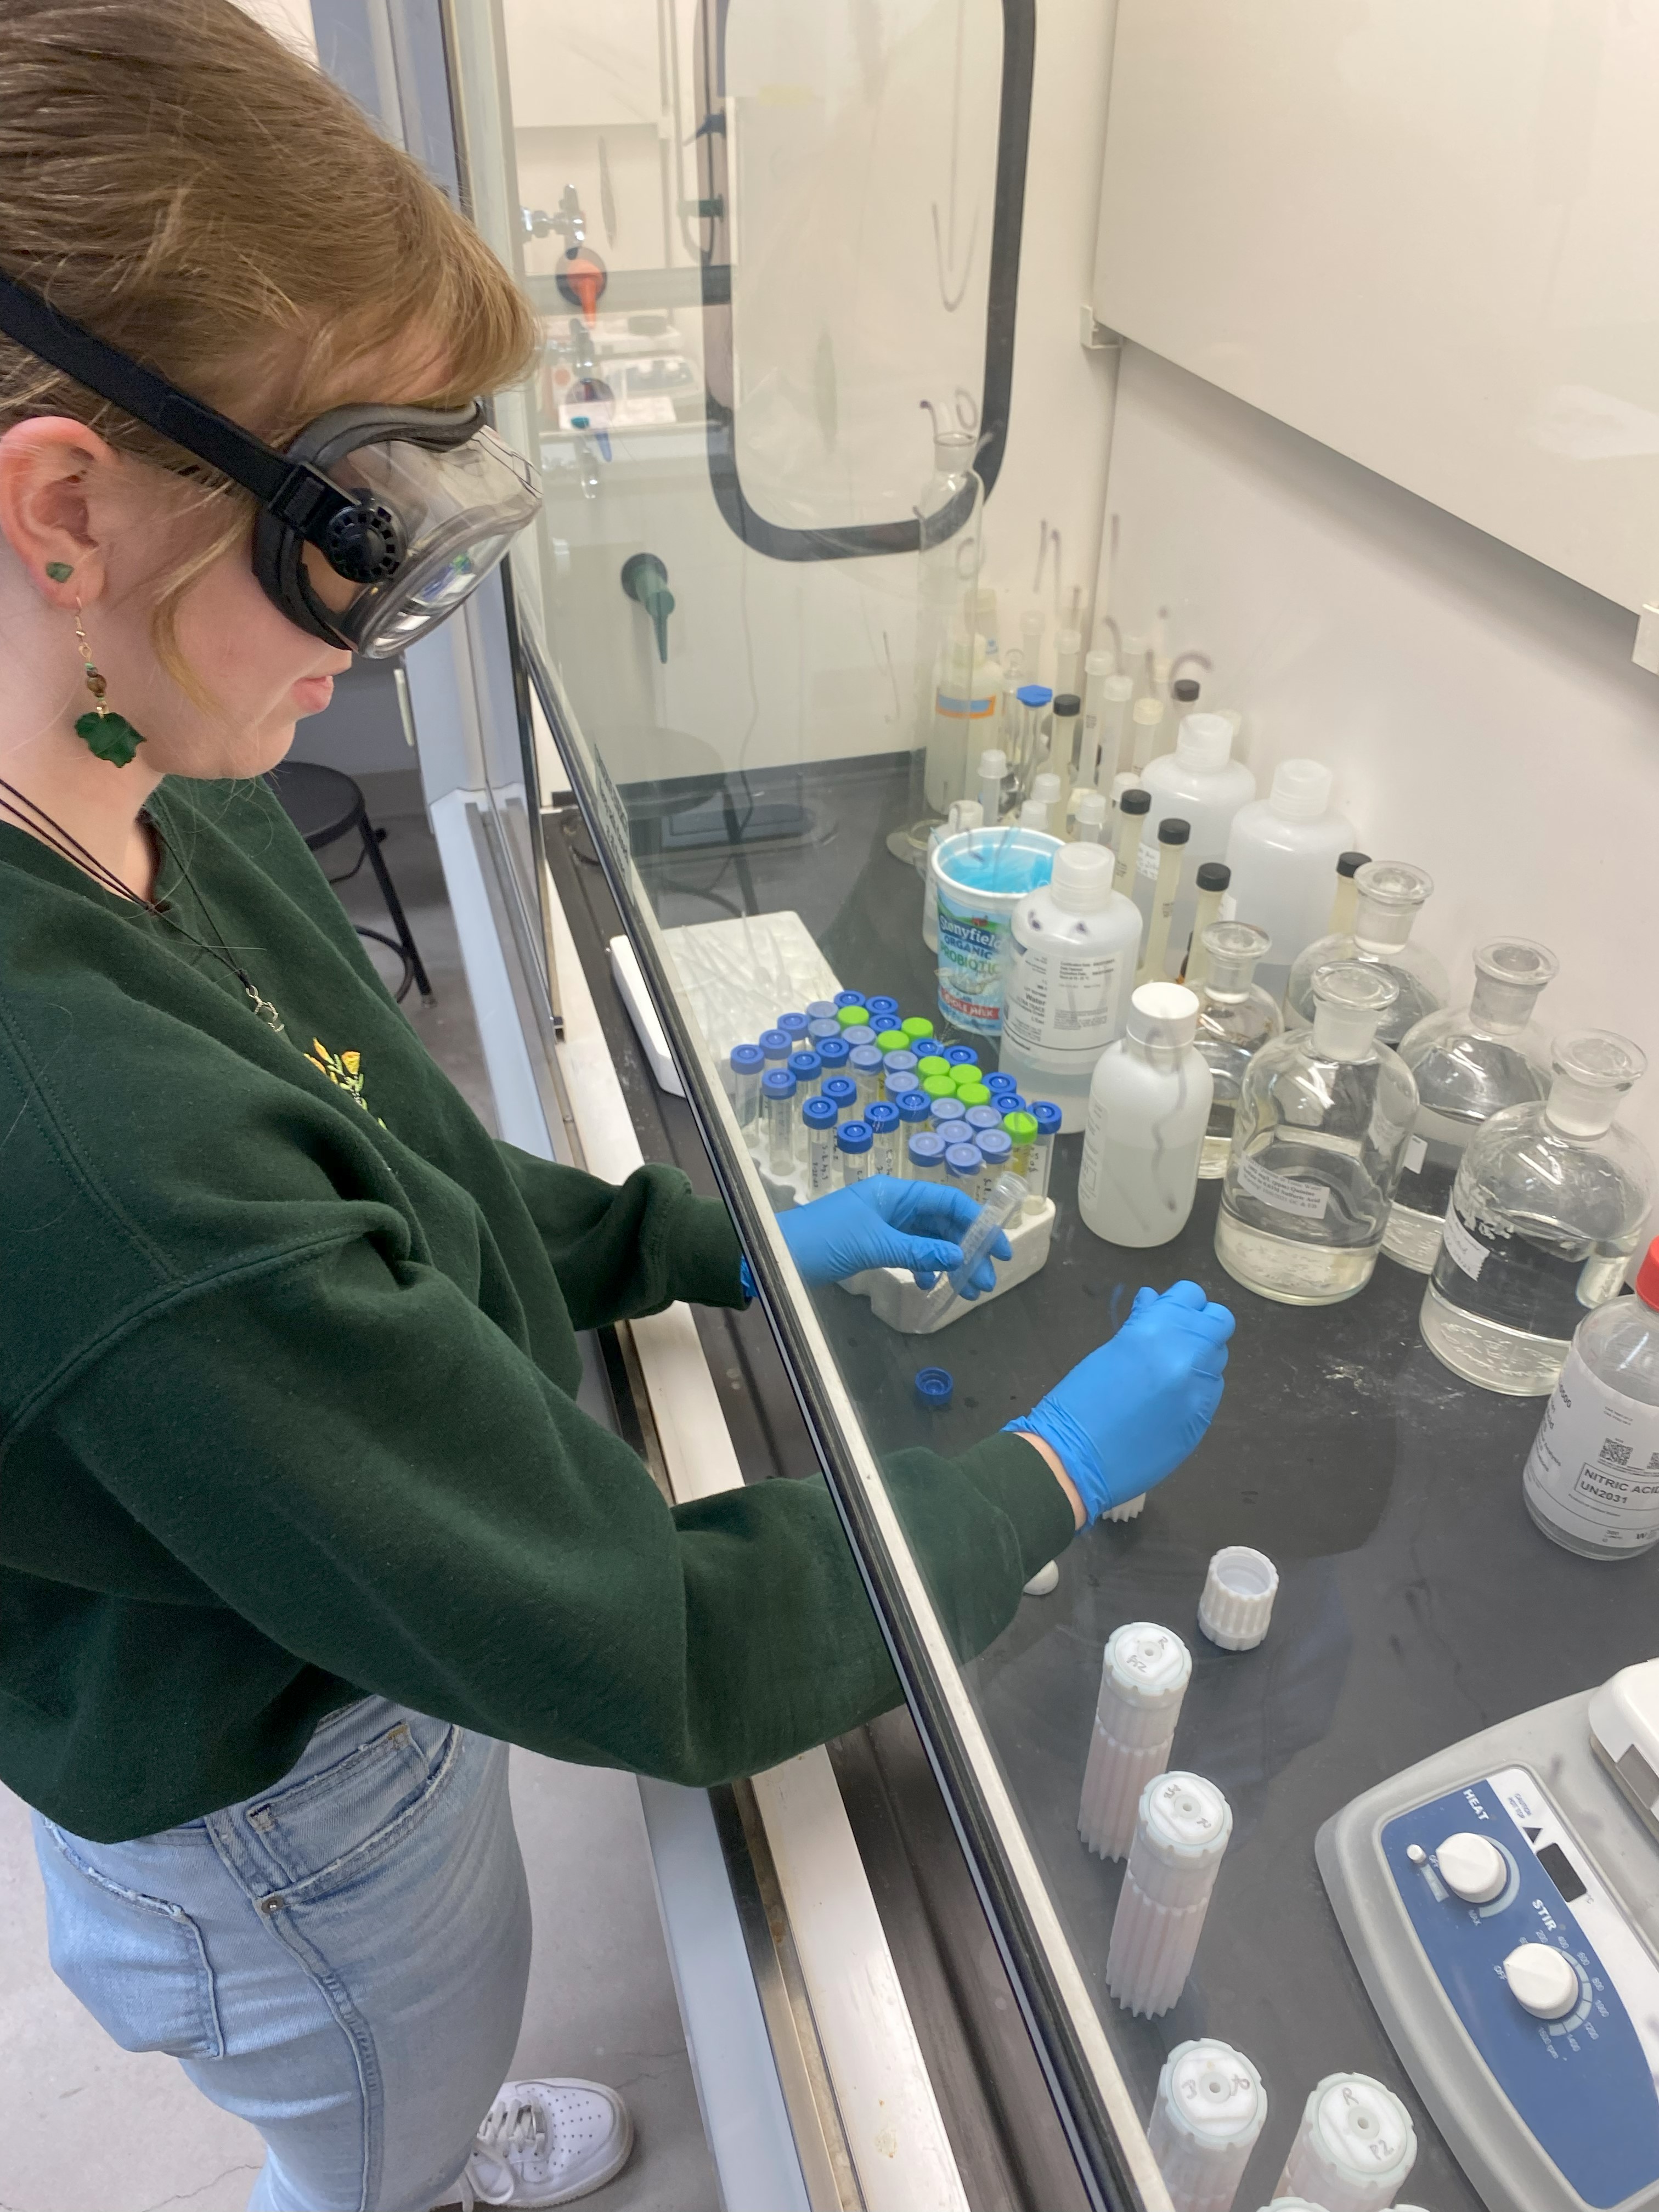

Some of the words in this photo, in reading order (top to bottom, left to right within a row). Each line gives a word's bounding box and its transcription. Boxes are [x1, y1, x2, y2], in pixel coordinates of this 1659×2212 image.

[944, 935, 994, 961] ORGANIC
[1025, 992, 1046, 1006] Water
[1584, 1468, 1629, 1491] NITRIC
[1580, 1481, 1628, 1504] UN2031
[1463, 1788, 1490, 1820] HEAT
[1468, 1909, 1482, 1927] MAX
[1531, 1898, 1558, 1932] STIR
[1536, 1929, 1550, 1944] 200
[1557, 1935, 1570, 1950] 400
[1492, 1965, 1507, 1981] OFF
[1341, 2086, 1359, 2106] R
